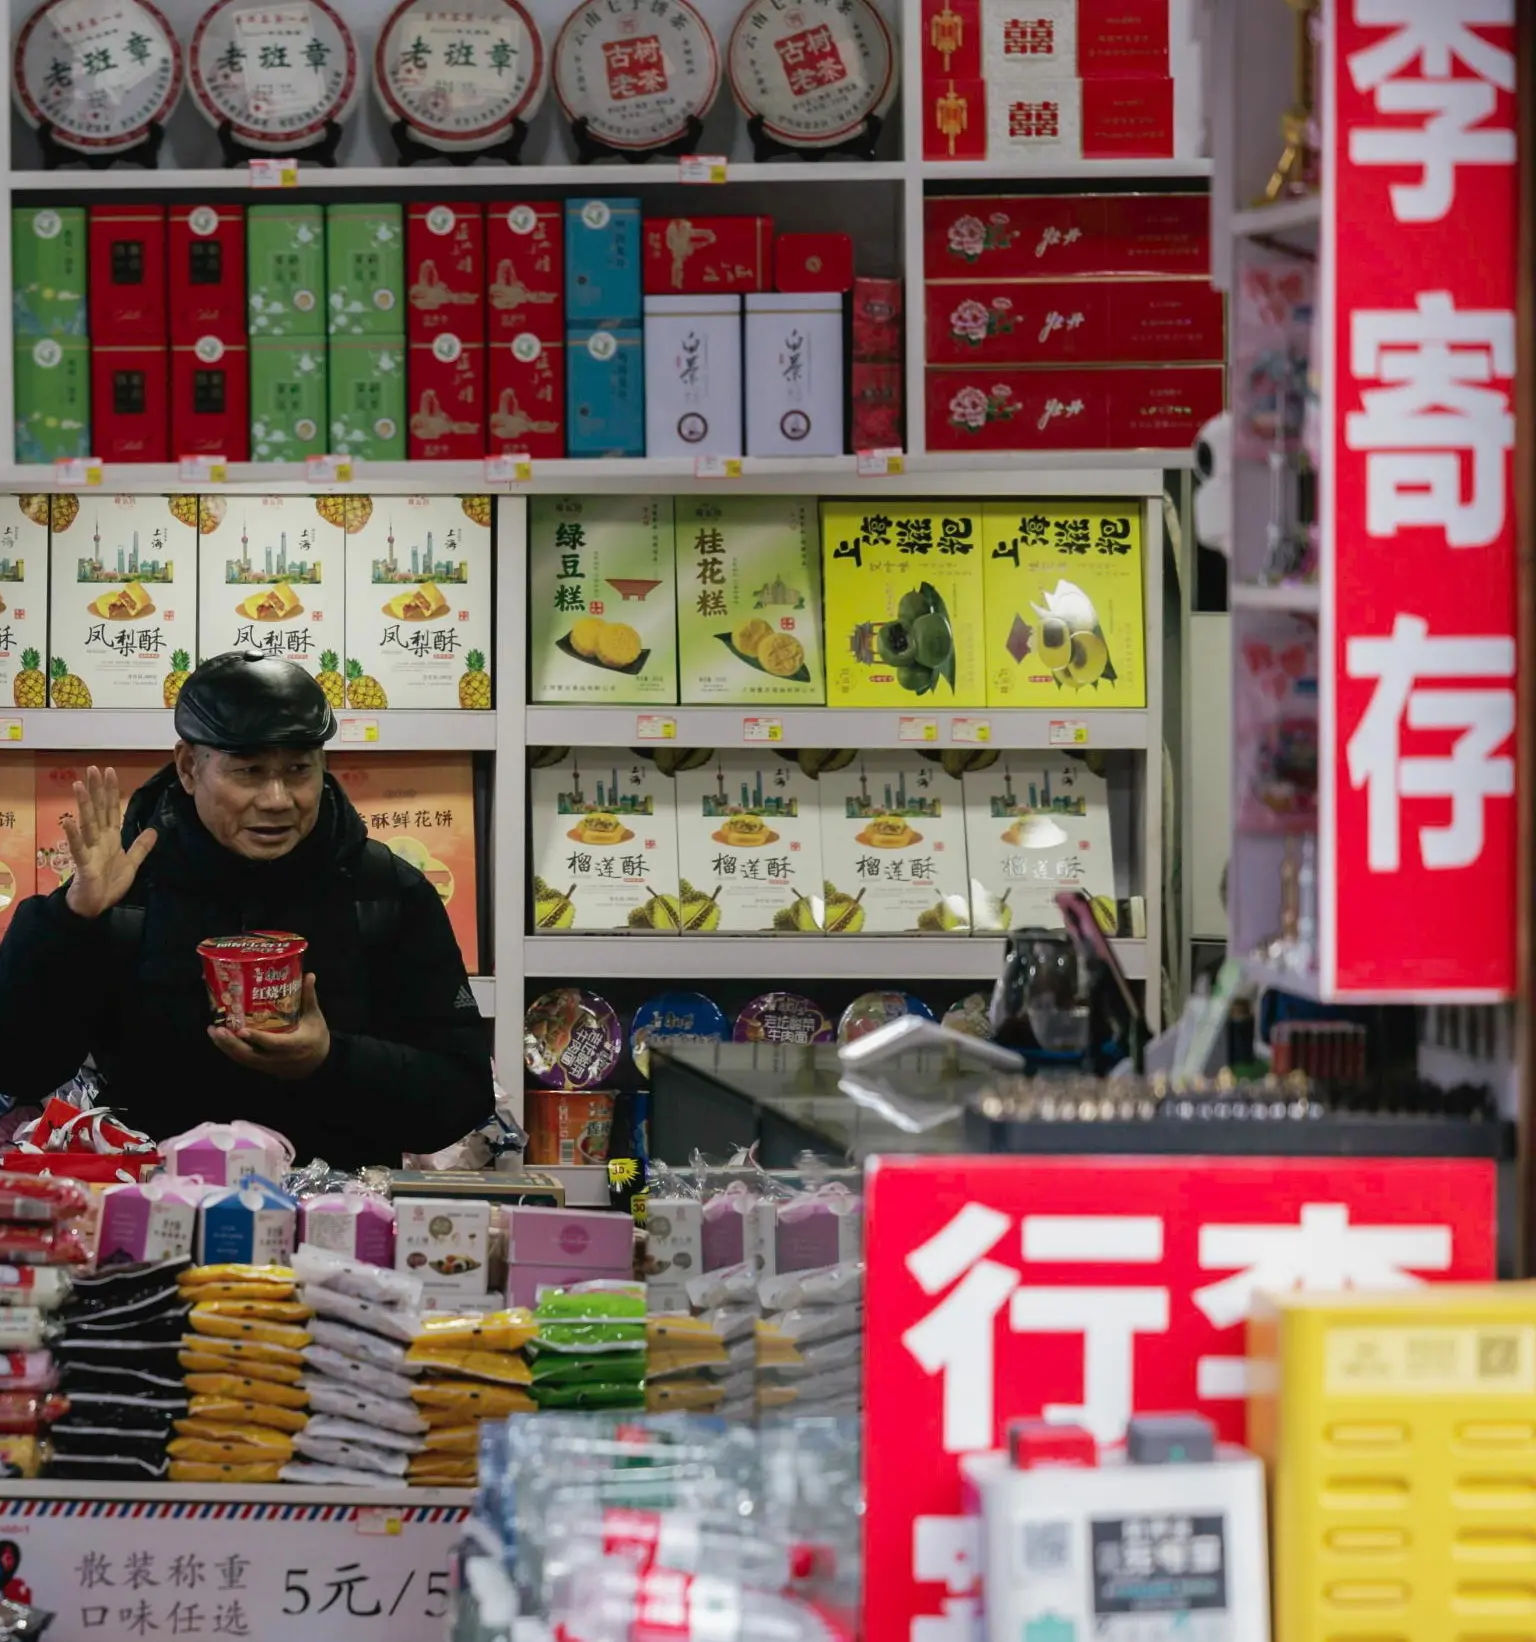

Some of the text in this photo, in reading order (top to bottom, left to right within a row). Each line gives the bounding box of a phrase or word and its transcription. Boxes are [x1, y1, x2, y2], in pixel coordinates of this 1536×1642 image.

[44, 30, 153, 89] 老班章
[217, 37, 332, 74] 老班章
[401, 36, 518, 77] 老班章
[1346, 0, 1517, 872] 李寄存
[833, 514, 974, 568] 上海糍粑
[992, 514, 1132, 568] 上海糍粑
[554, 521, 587, 613] 绿豆糕
[694, 528, 728, 617] 桂花糕
[84, 623, 168, 657] 凤梨酥
[233, 624, 316, 655] 凤梨酥
[380, 624, 463, 658] 凤梨酥
[566, 850, 650, 879] 榴莲酥
[712, 852, 796, 881] 榴莲酥
[856, 854, 941, 882] 榴莲酥
[1000, 855, 1086, 880] 榴莲酥
[74, 1551, 252, 1592] 散装称重
[79, 1600, 252, 1639] 口味任选
